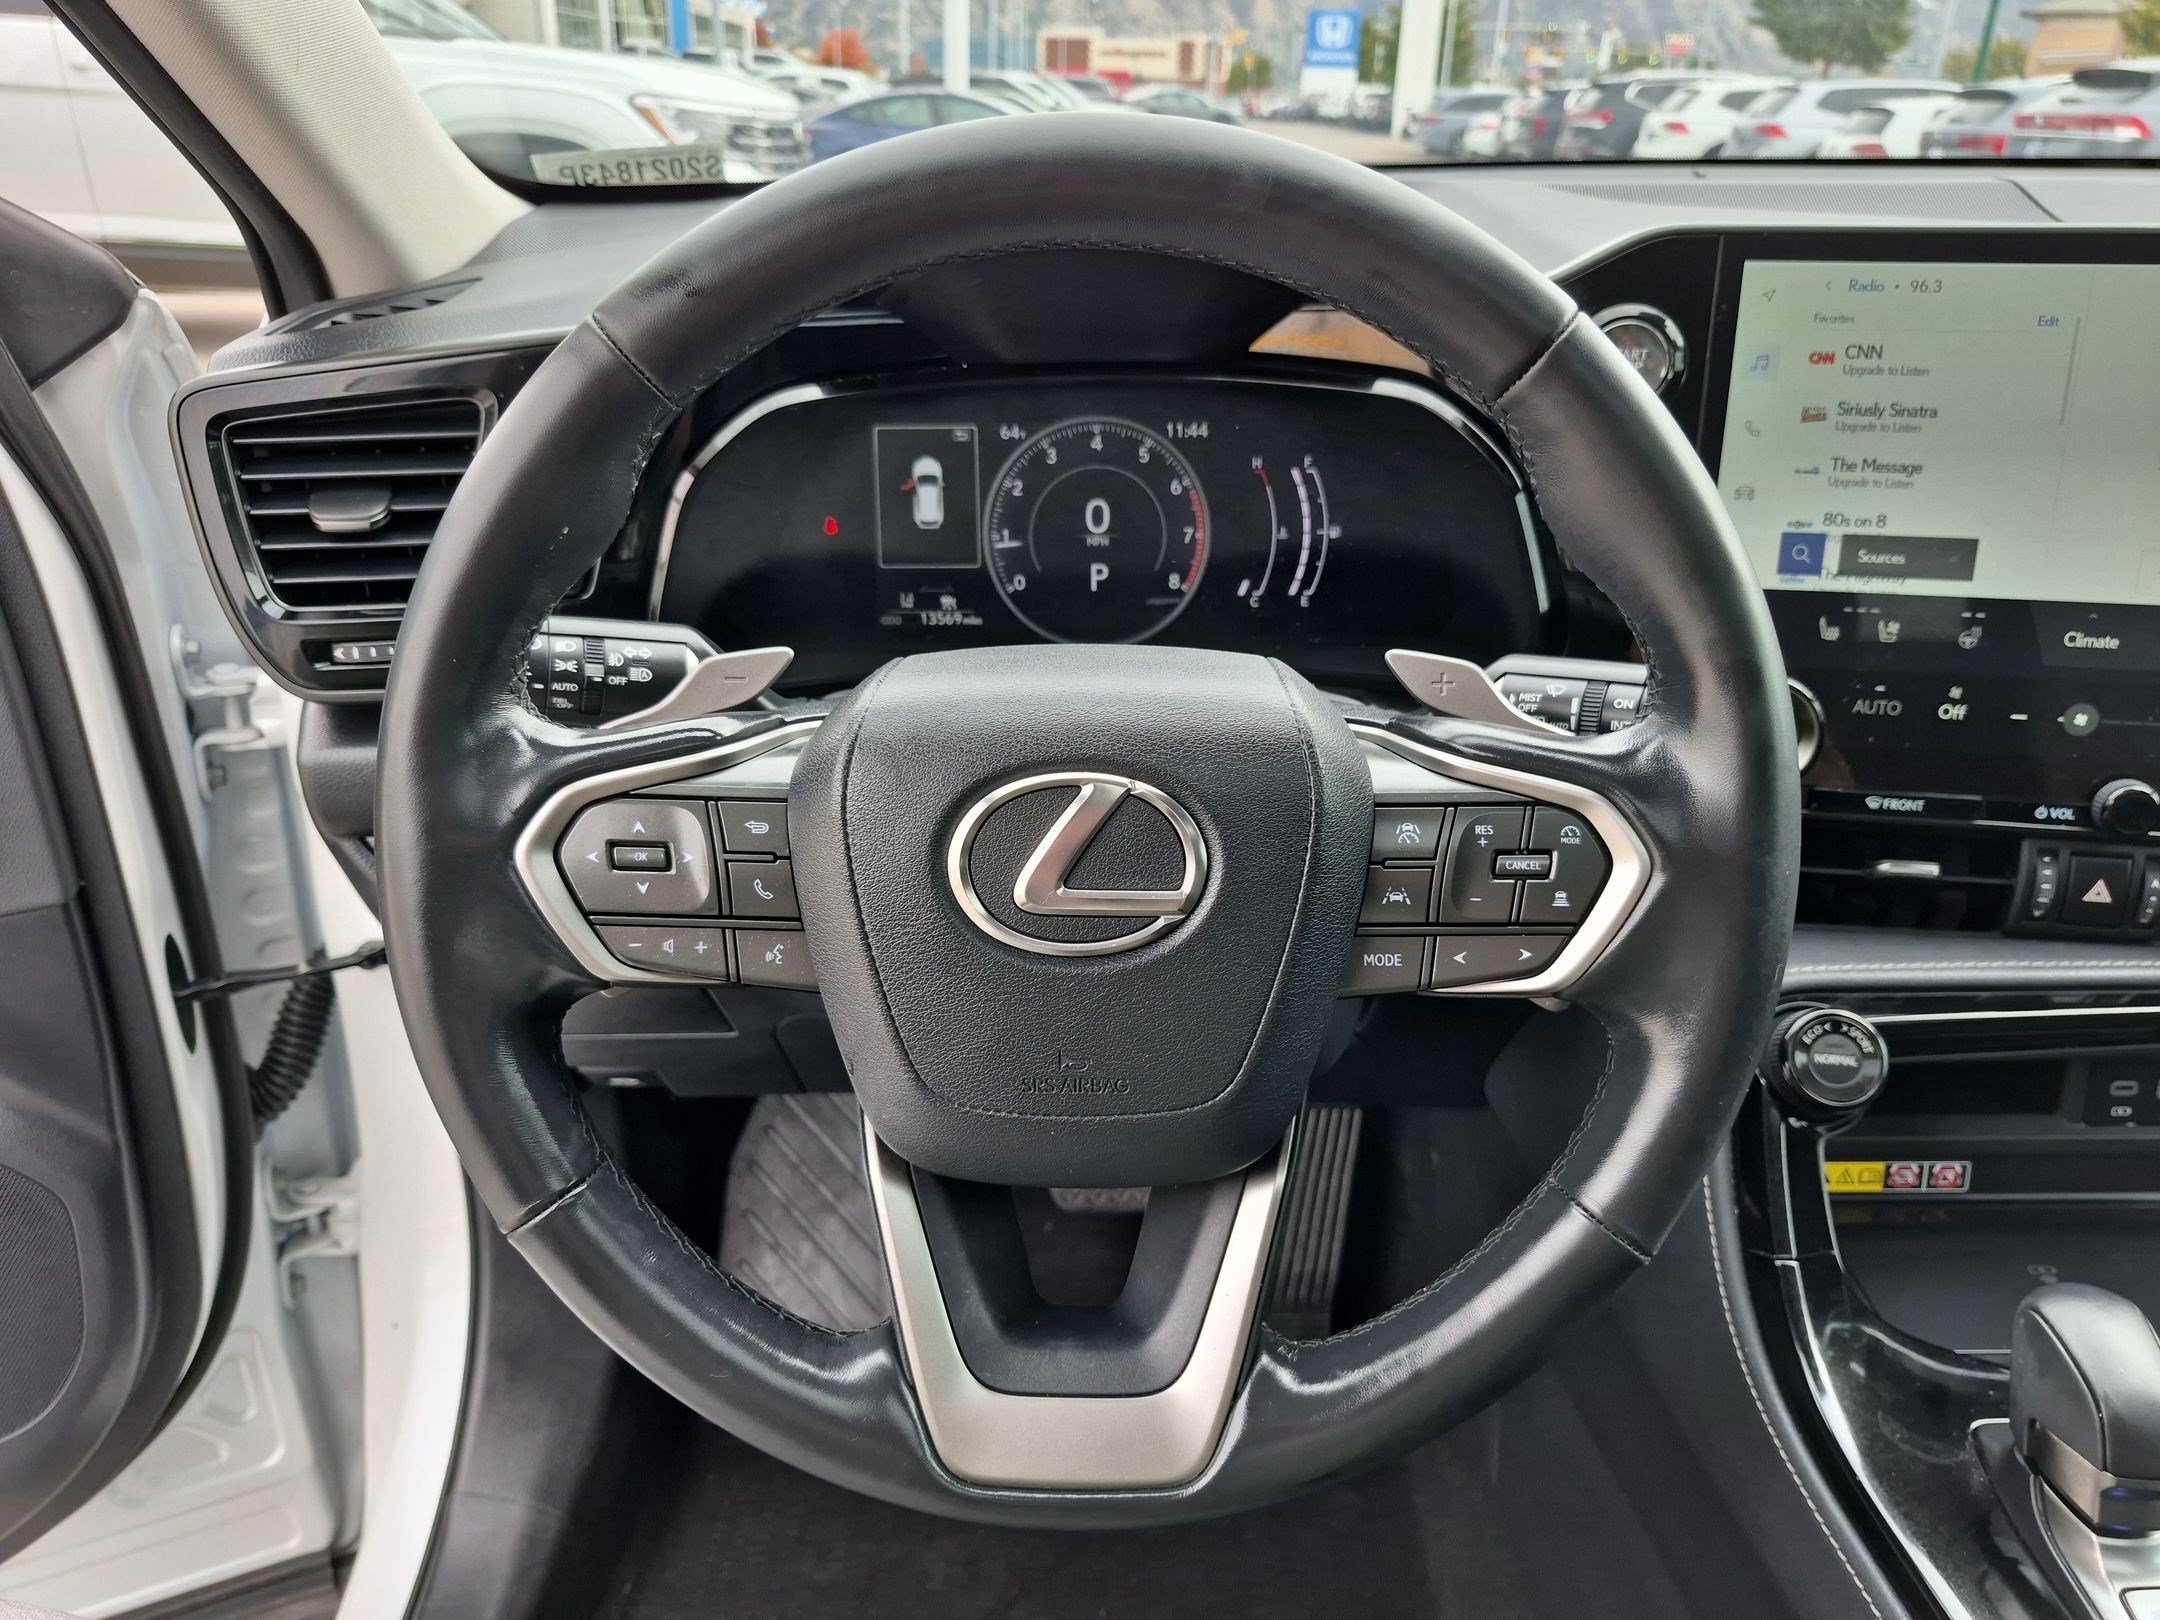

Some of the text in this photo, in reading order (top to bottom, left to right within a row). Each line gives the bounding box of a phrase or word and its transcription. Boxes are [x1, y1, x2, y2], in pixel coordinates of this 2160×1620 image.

[1848, 279, 1943, 293] Radio 96.3
[1813, 312, 1855, 325] Favorites
[2038, 315, 2059, 327] Edit
[1845, 345, 1884, 360] CNN
[1843, 365, 1930, 378] Upgrade to Listen
[1837, 401, 1884, 420] Siriusly
[1889, 403, 1938, 419] Sinatra
[1166, 421, 1209, 438] 11:44
[1835, 419, 1922, 433] Upgrade to Listen
[1090, 434, 1103, 451] 4
[1046, 447, 1057, 465] 3
[1138, 446, 1150, 464] 5
[1830, 457, 1923, 478] The Message
[1012, 478, 1024, 497] 2
[1170, 478, 1183, 496] 6
[1828, 476, 1914, 490] Upgrade to Listen
[1085, 497, 1110, 534] 0
[1823, 512, 1850, 528] 80s
[1854, 516, 1873, 529] on
[1876, 513, 1887, 529] 8
[1183, 526, 1194, 545] 7
[1857, 549, 1906, 565] Sources
[1013, 573, 1027, 592] 0
[1090, 562, 1109, 592] P
[1168, 572, 1182, 590] 8
[920, 610, 963, 626] 13569
[2063, 631, 2120, 650] Climate
[551, 682, 579, 692] AUTO
[608, 675, 628, 686] OFF
[1518, 692, 1543, 703] MIST
[1614, 699, 1634, 709] ON
[1518, 703, 1538, 713] OFF
[1851, 700, 1902, 717] AUTO
[1937, 703, 1968, 721] Off
[1881, 797, 1926, 812] FRONT
[2049, 807, 2076, 821] VOL
[1474, 825, 1493, 835] RES
[1560, 837, 1581, 845] MODE
[635, 853, 648, 863] OK
[1505, 860, 1541, 871] CANCEL
[1363, 953, 1403, 967] MODE
[1801, 1024, 1875, 1053] ECO SPORT
[1814, 1053, 1858, 1067] NORMAL
[1021, 1078, 1131, 1094] SRS AIRBAG
